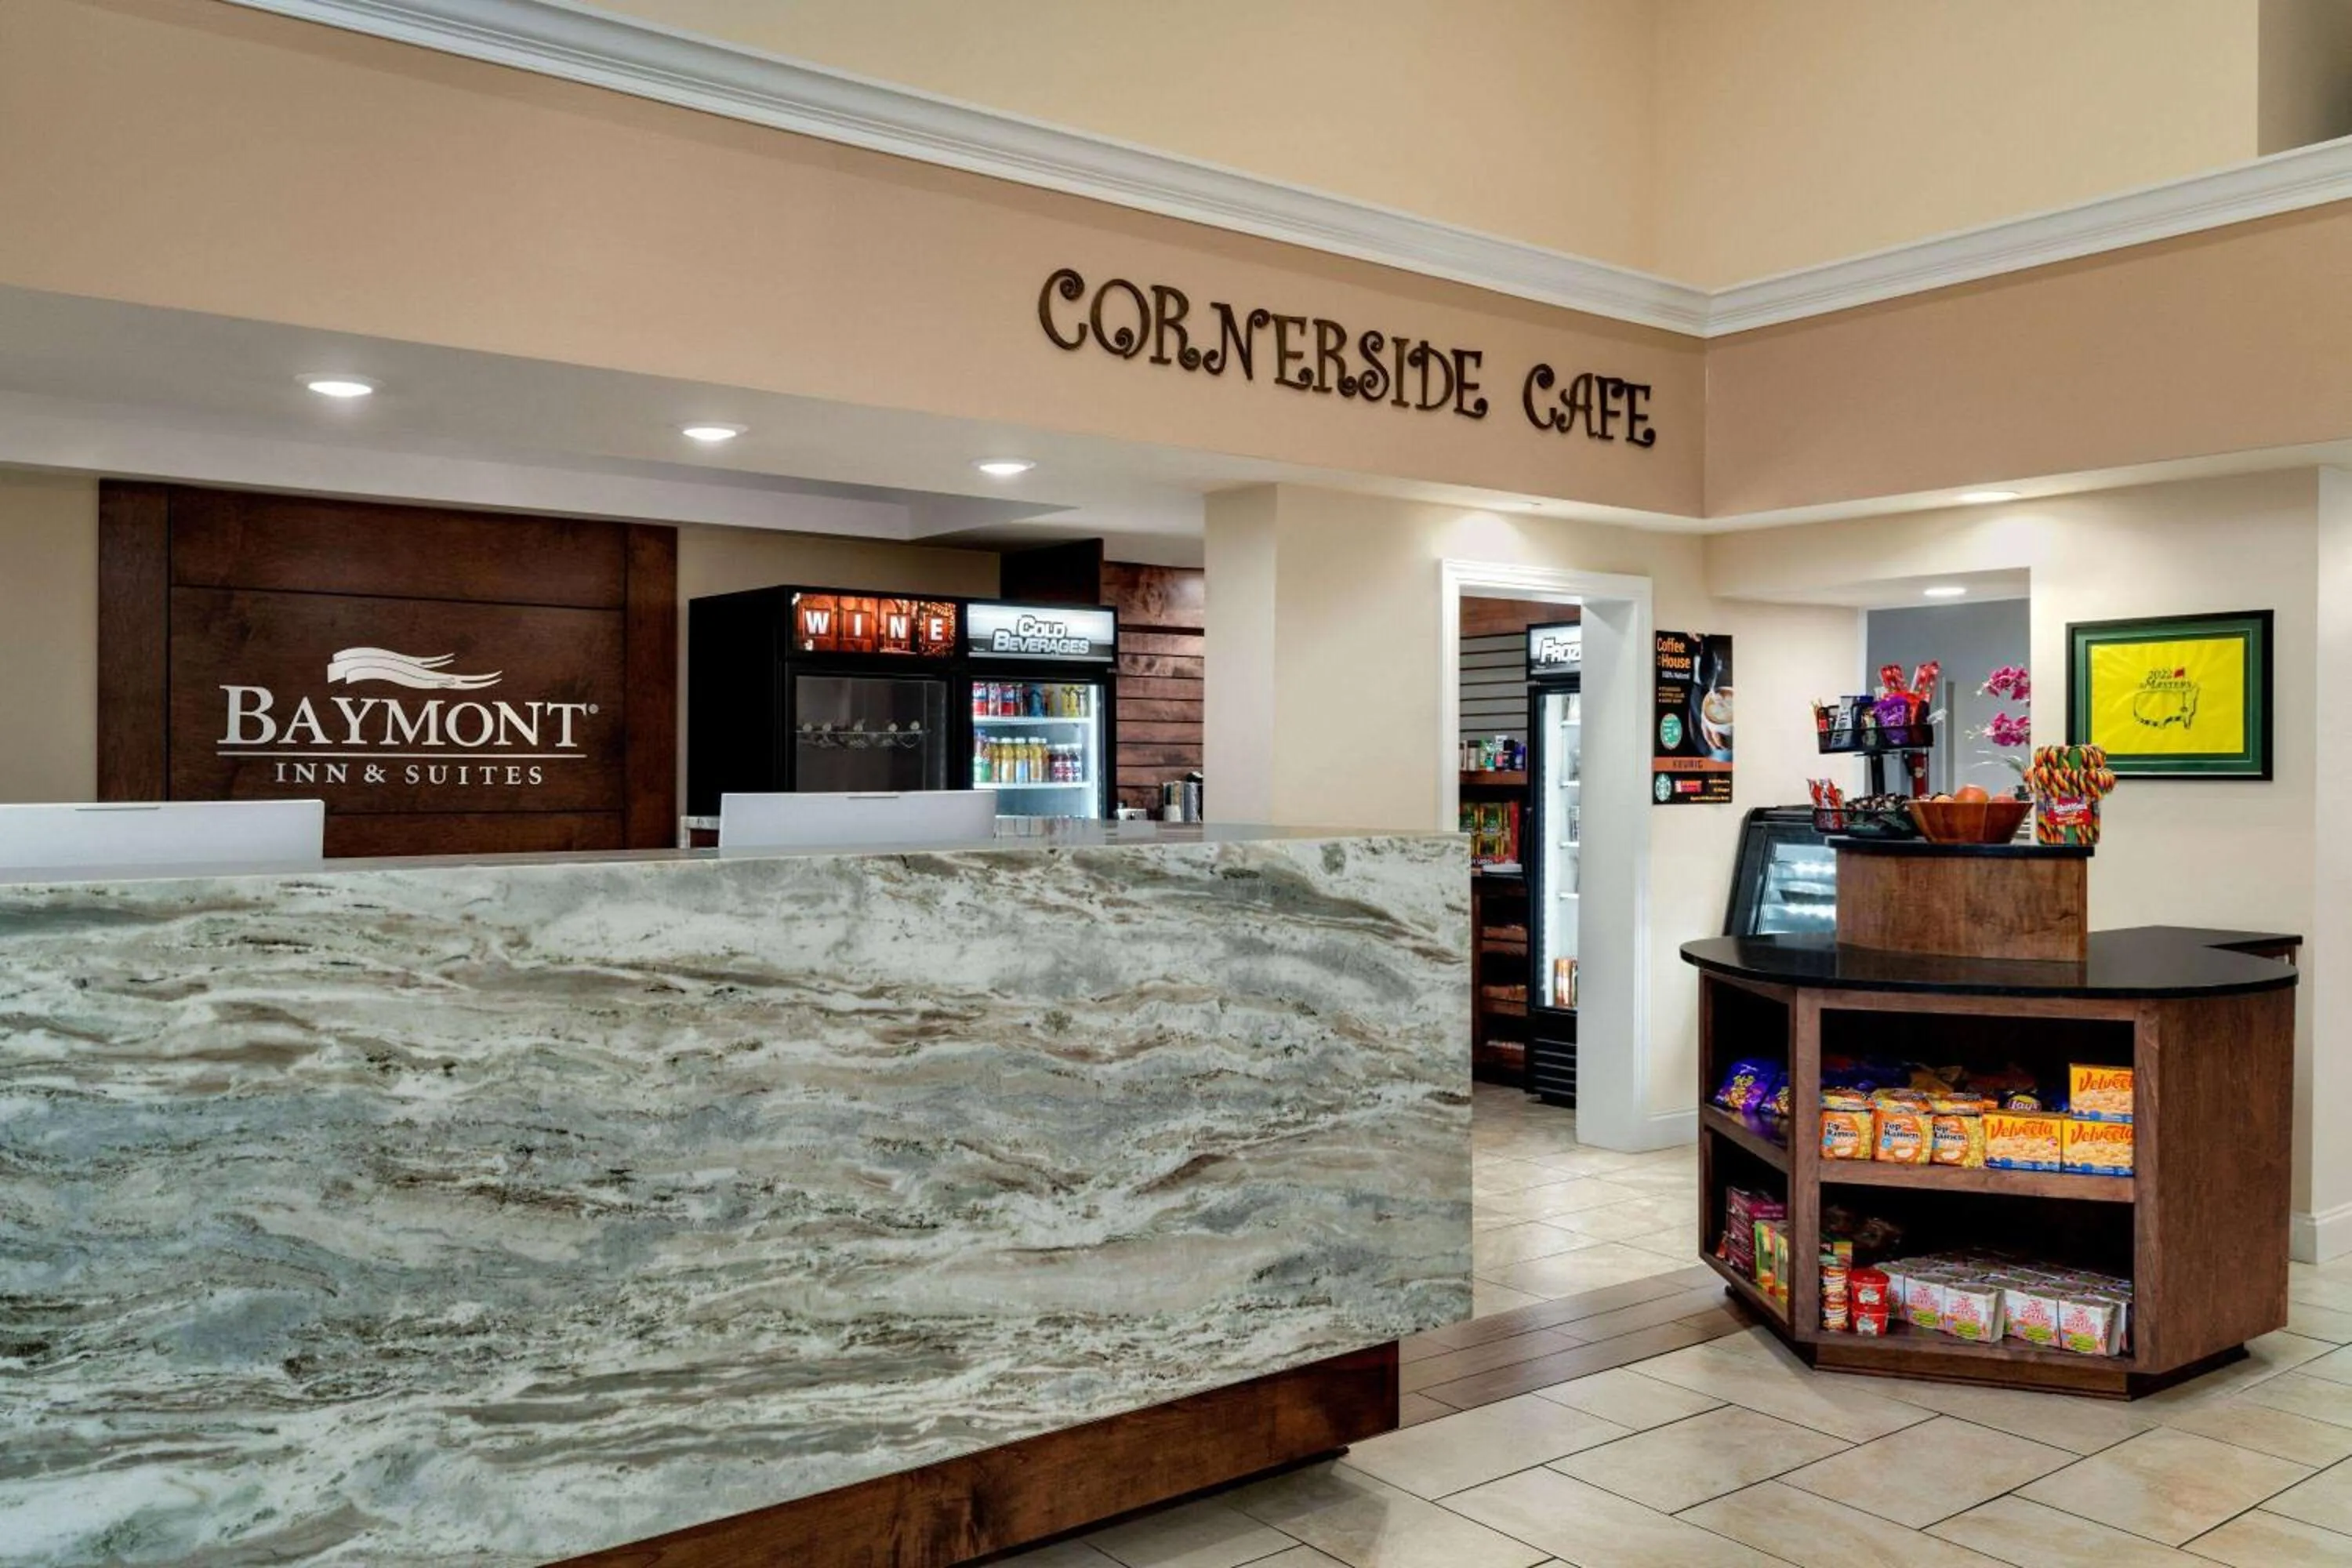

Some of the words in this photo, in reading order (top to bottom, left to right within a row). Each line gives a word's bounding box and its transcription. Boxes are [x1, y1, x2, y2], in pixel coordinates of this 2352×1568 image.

[1038, 267, 1488, 419] CORNERSIDE
[1523, 363, 1656, 448] CAFE
[804, 610, 944, 641] WINE
[1018, 615, 1067, 638] COLD
[993, 629, 1091, 655] BEVERAGES
[1657, 637, 1685, 653] Coffee
[1661, 653, 1691, 669] House
[216, 684, 588, 748] BAYMONT
[276, 763, 349, 783] INN
[364, 763, 387, 783] &
[405, 764, 543, 785] SUITES
[2078, 1070, 2133, 1092] Velveet
[1991, 1119, 2053, 1140] Velveeta
